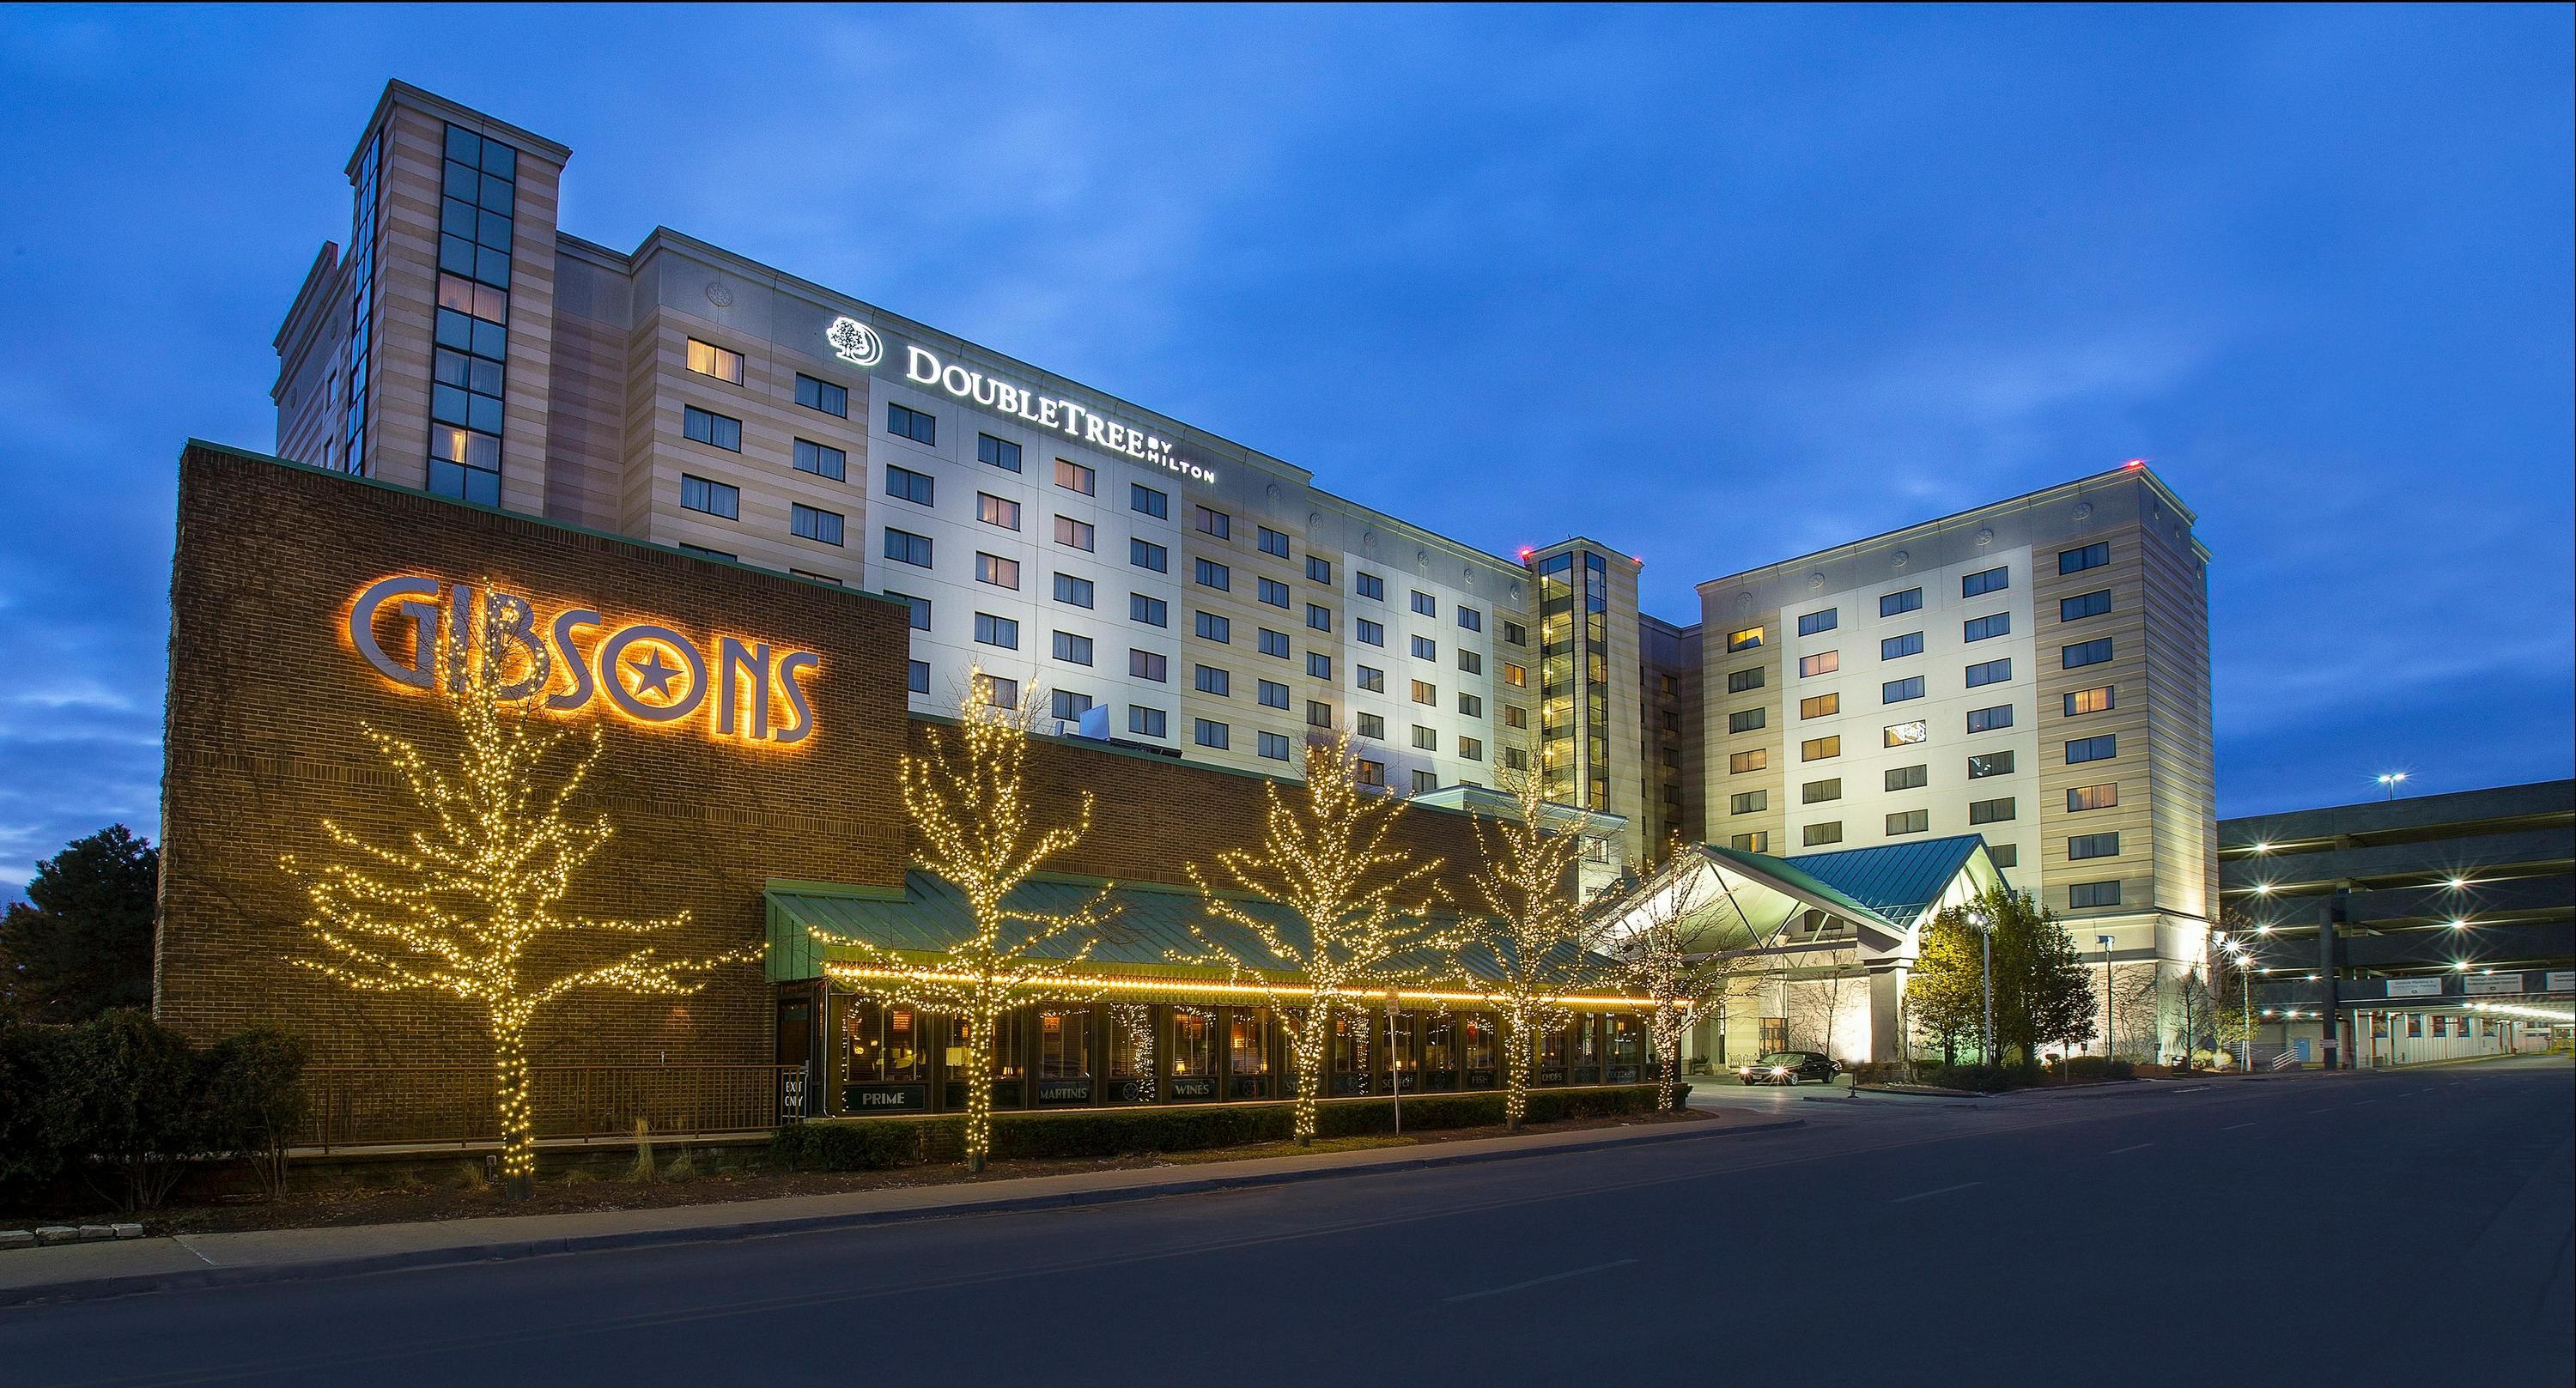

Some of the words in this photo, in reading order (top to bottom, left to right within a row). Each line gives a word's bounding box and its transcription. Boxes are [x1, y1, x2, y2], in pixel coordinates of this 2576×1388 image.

[1148, 436, 1173, 454] BY
[1147, 451, 1216, 483] HILTON
[349, 576, 820, 743] GIBSONS
[1382, 1078, 1413, 1088] SCTCH
[1472, 1076, 1489, 1084] FISH
[1542, 1072, 1563, 1082] CHOPS
[785, 1081, 803, 1093] EXT
[1175, 1084, 1210, 1095] WINES
[862, 1092, 904, 1106] PRIME
[1040, 1088, 1088, 1100] MARTINIS
[784, 1094, 804, 1107] ONY
